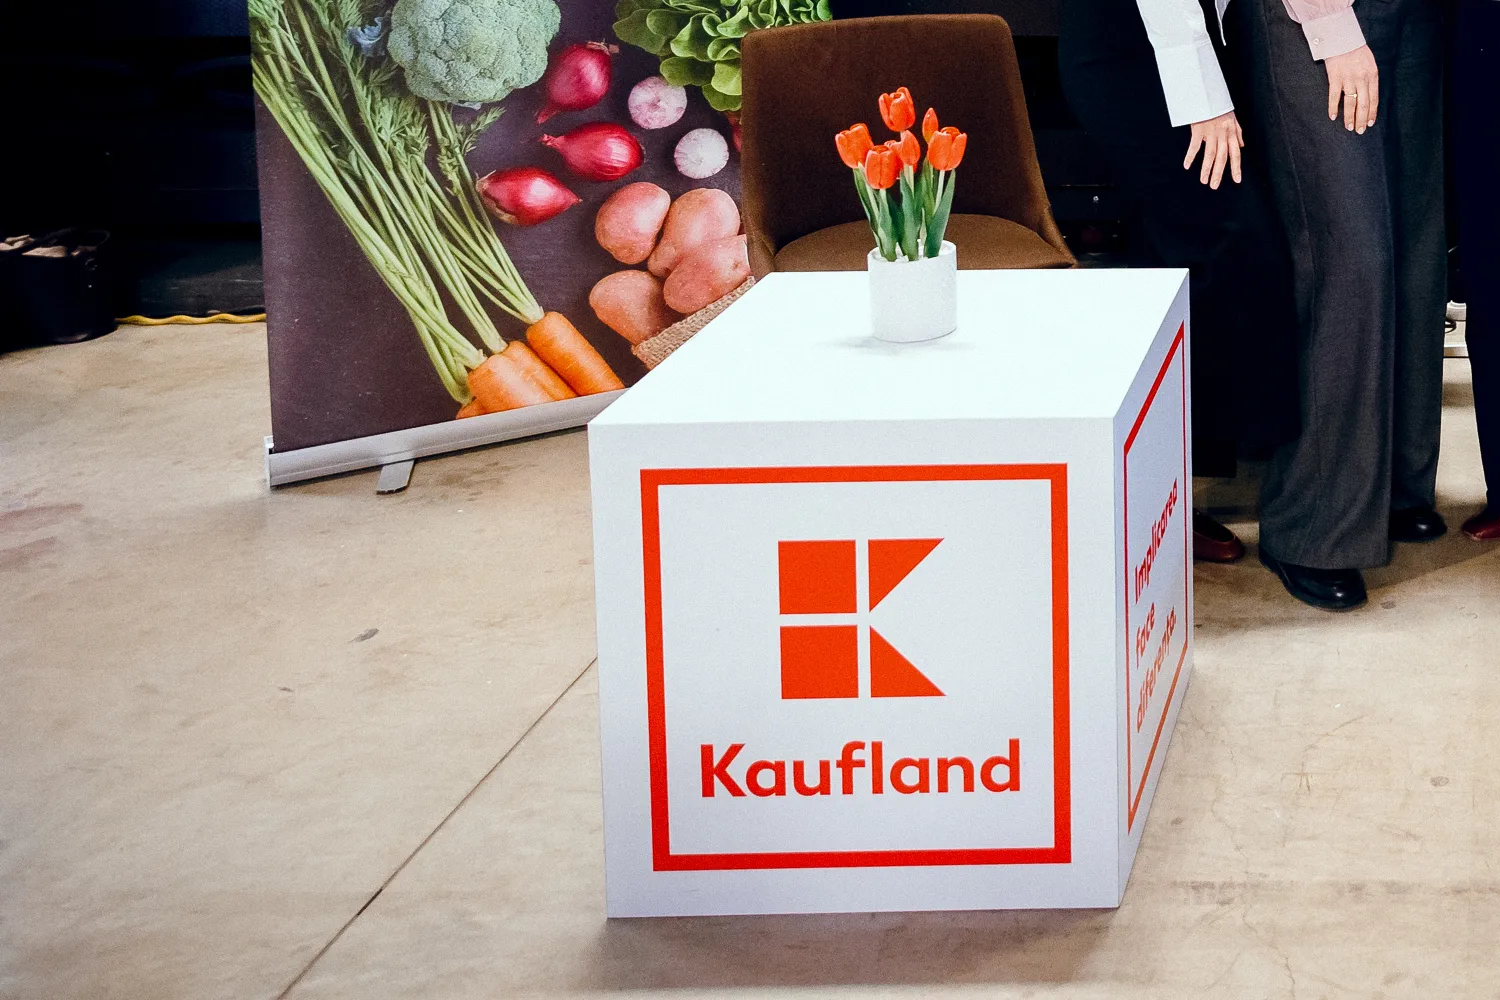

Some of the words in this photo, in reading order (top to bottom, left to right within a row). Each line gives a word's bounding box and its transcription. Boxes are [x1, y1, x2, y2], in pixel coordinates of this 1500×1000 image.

[1134, 477, 1178, 605] Implicarea
[1136, 601, 1155, 669] face
[700, 737, 1021, 799] Kaufland
